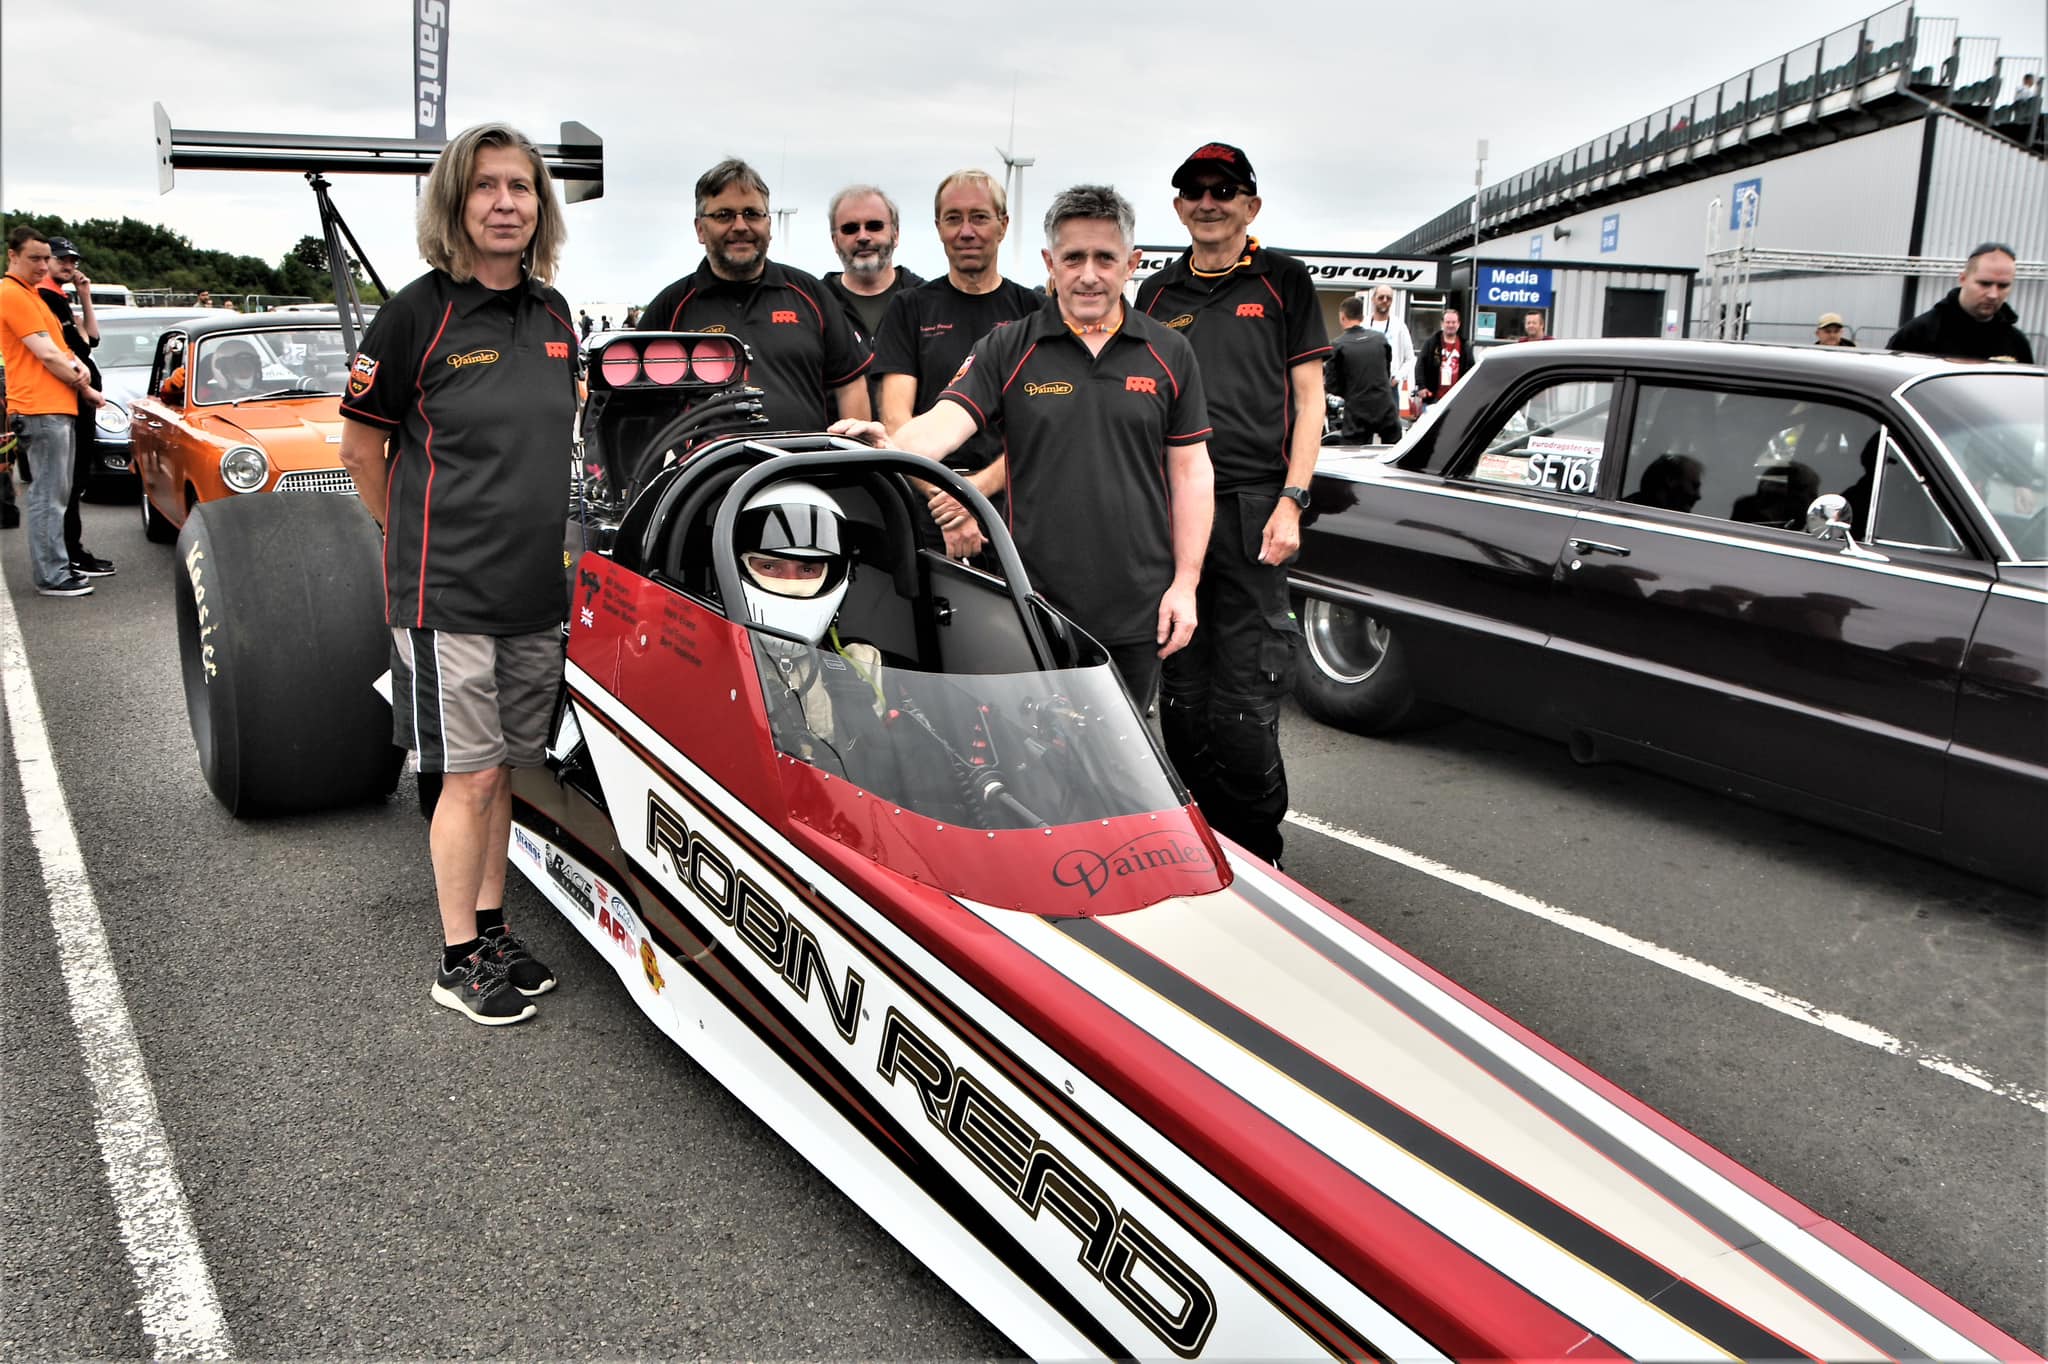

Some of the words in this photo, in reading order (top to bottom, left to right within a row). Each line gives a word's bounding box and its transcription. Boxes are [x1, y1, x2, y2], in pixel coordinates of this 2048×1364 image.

[419, 0, 445, 127] Santa
[1306, 264, 1423, 282] ography
[1491, 269, 1538, 284] Media
[1488, 287, 1540, 302] Centre
[772, 311, 800, 323] RRR
[1236, 304, 1264, 318] RRR
[447, 349, 499, 368] Daimler
[1024, 381, 1072, 396] Daimler
[1125, 376, 1157, 395] RRR
[1528, 453, 1600, 493] SE161
[1053, 831, 1214, 898] Daimler
[554, 854, 593, 898] RACE
[647, 788, 865, 1045] ROBIN
[877, 1005, 1217, 1360] READ
